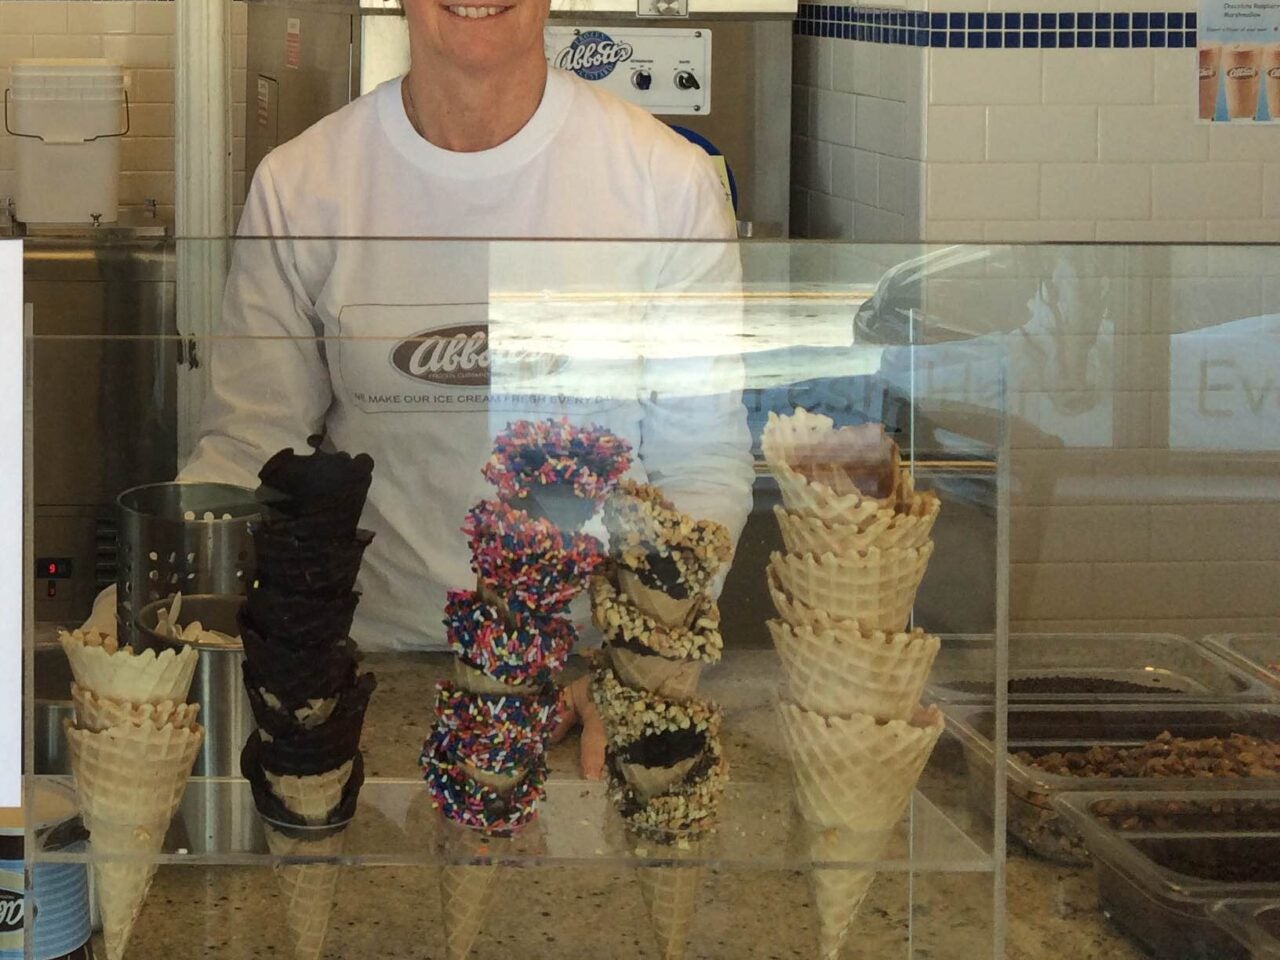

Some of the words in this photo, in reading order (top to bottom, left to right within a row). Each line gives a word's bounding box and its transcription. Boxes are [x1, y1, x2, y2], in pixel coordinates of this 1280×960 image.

[368, 394, 401, 404] MAKE
[404, 394, 430, 403] OUR
[433, 394, 454, 403] ICE
[457, 394, 501, 403] CREAM
